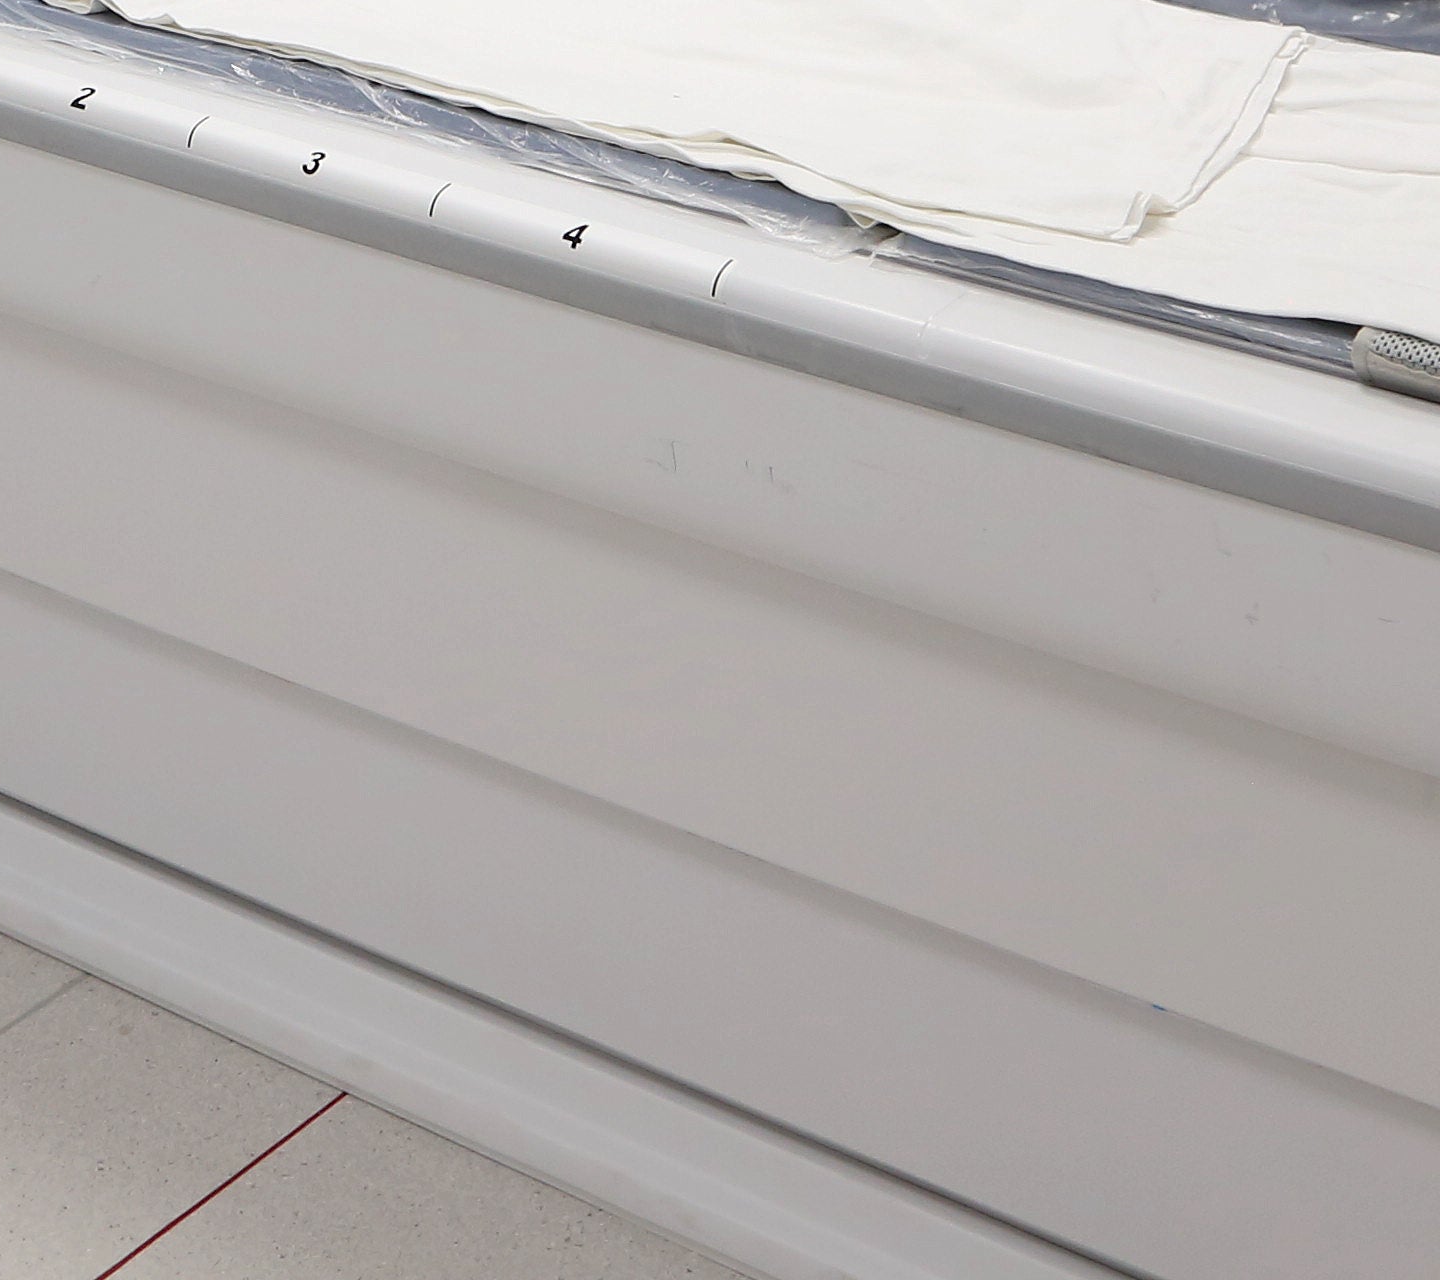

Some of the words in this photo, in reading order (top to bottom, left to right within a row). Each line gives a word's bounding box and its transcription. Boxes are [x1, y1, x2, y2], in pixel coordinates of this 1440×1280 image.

[70, 87, 97, 110] 2
[301, 151, 326, 175] 3
[562, 224, 590, 249] 4
